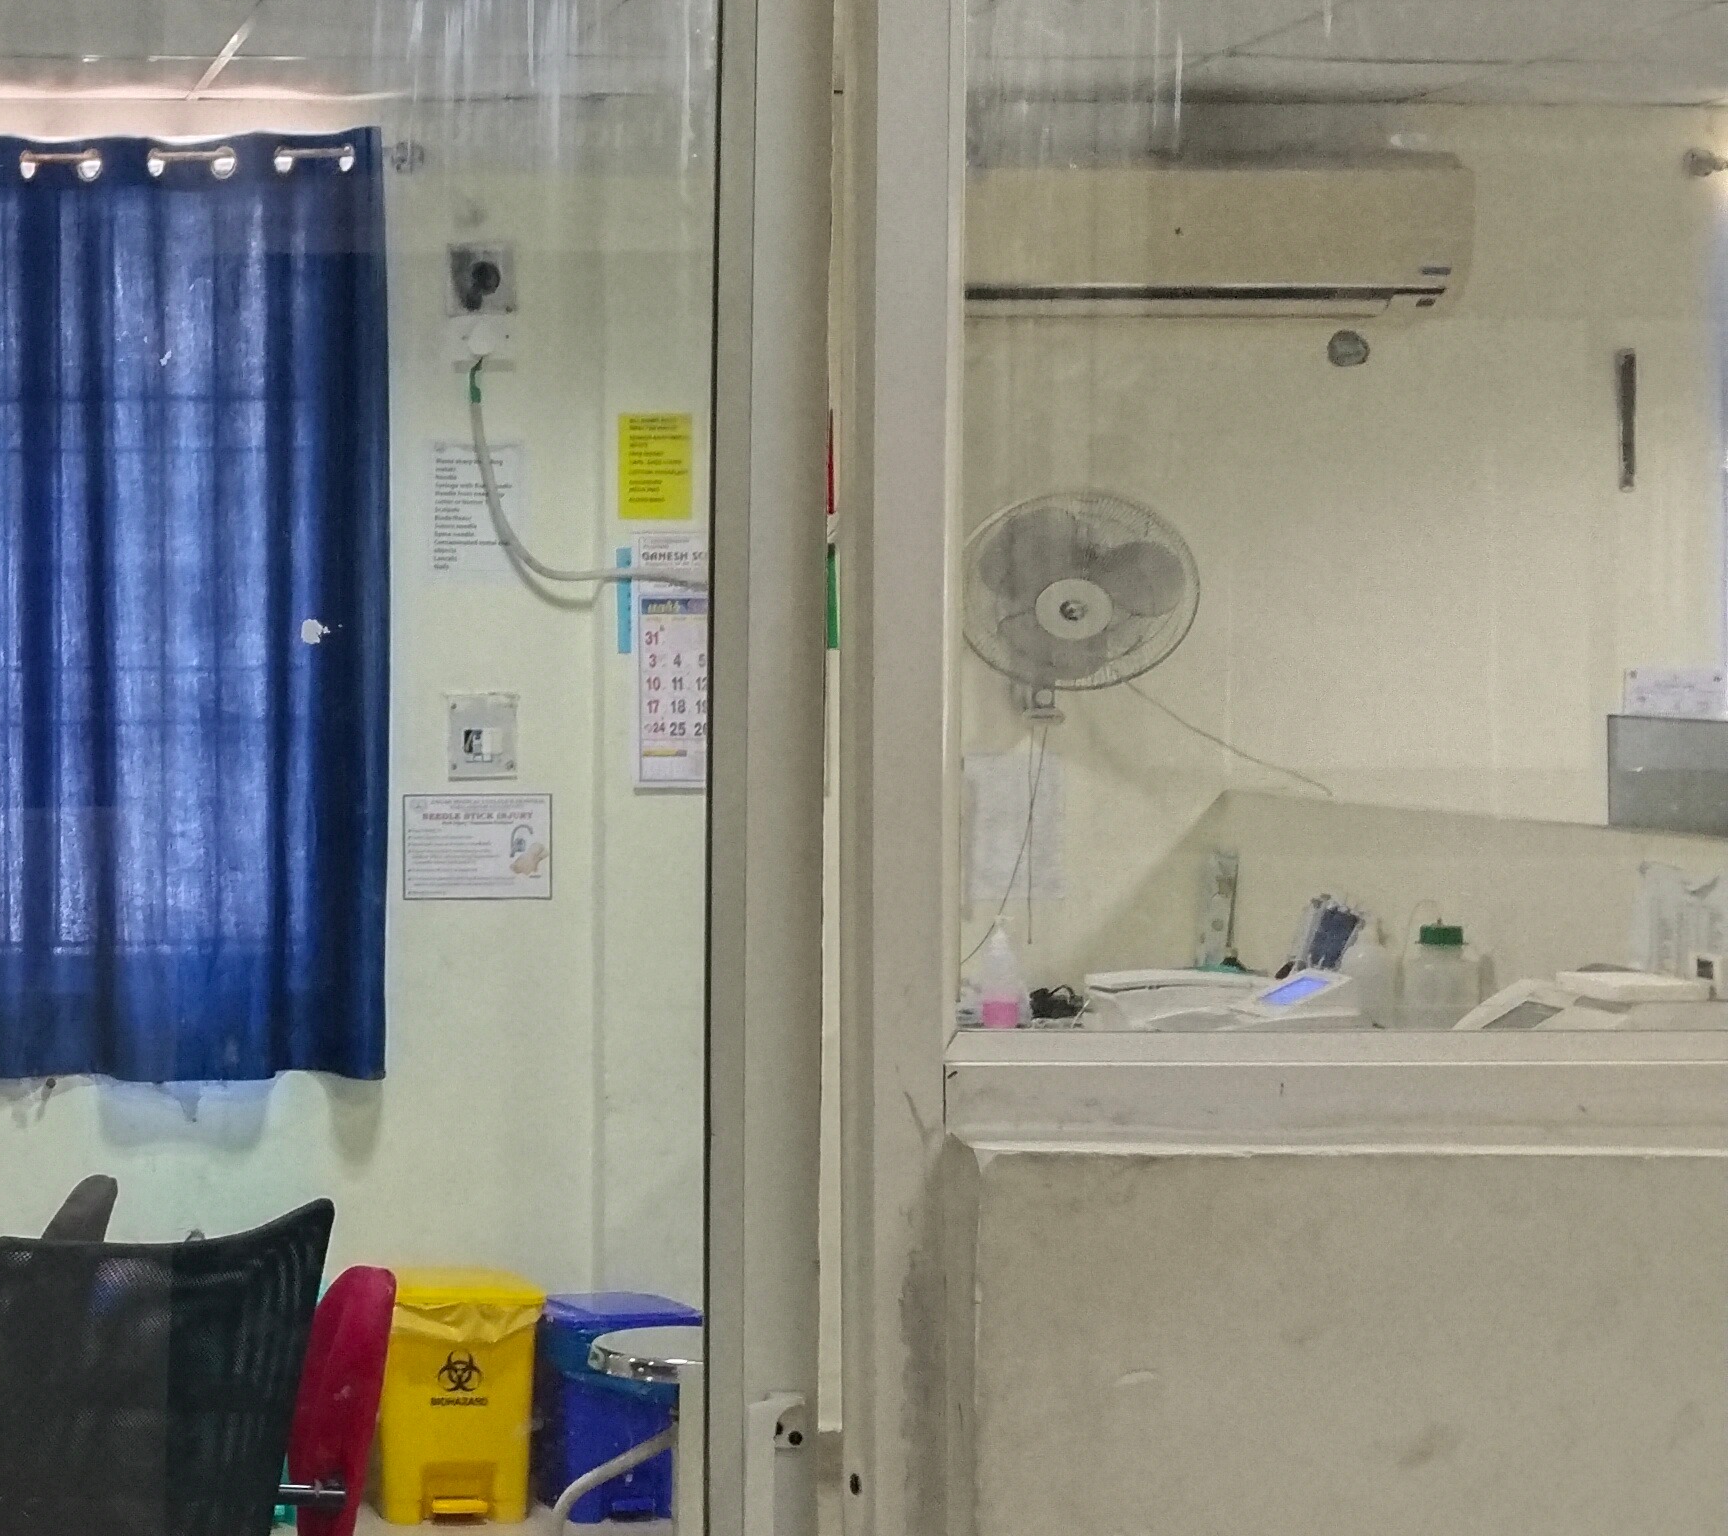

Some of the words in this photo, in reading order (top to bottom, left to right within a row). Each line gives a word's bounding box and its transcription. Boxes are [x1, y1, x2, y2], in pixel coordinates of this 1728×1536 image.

[645, 631, 659, 645] 31
[649, 654, 658, 668] 3
[673, 653, 682, 668] 4
[646, 677, 661, 691] 10
[671, 677, 684, 691] 11
[647, 699, 659, 714] 17
[670, 699, 686, 714] 18
[652, 722, 666, 734] 24
[669, 722, 686, 736] 25
